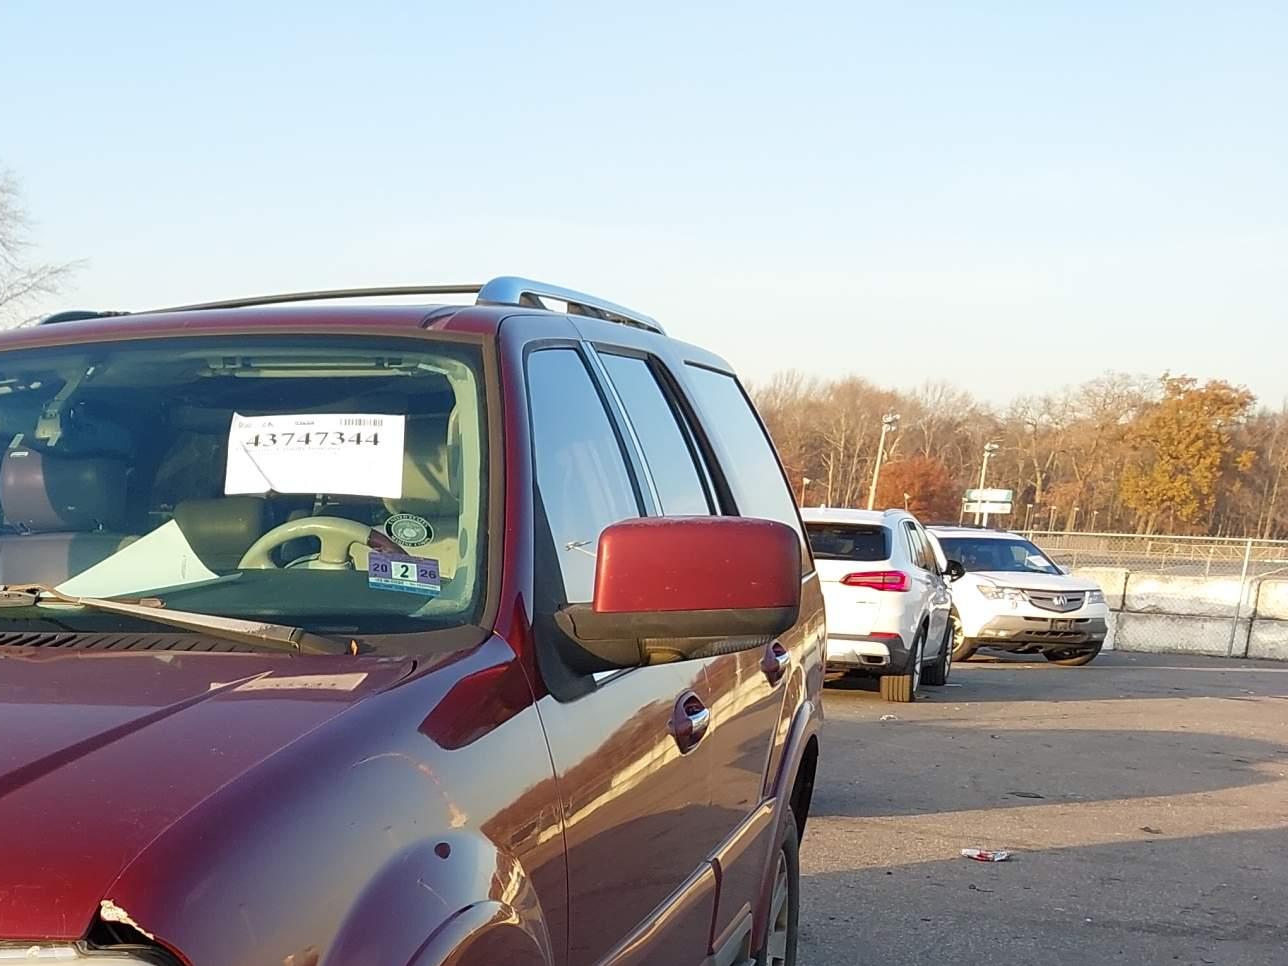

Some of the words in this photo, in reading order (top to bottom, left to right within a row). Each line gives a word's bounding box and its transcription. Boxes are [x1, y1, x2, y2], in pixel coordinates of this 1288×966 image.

[246, 431, 380, 447] 43747344
[372, 563, 388, 573] 20
[400, 564, 409, 578] 2
[420, 569, 437, 579] 26
